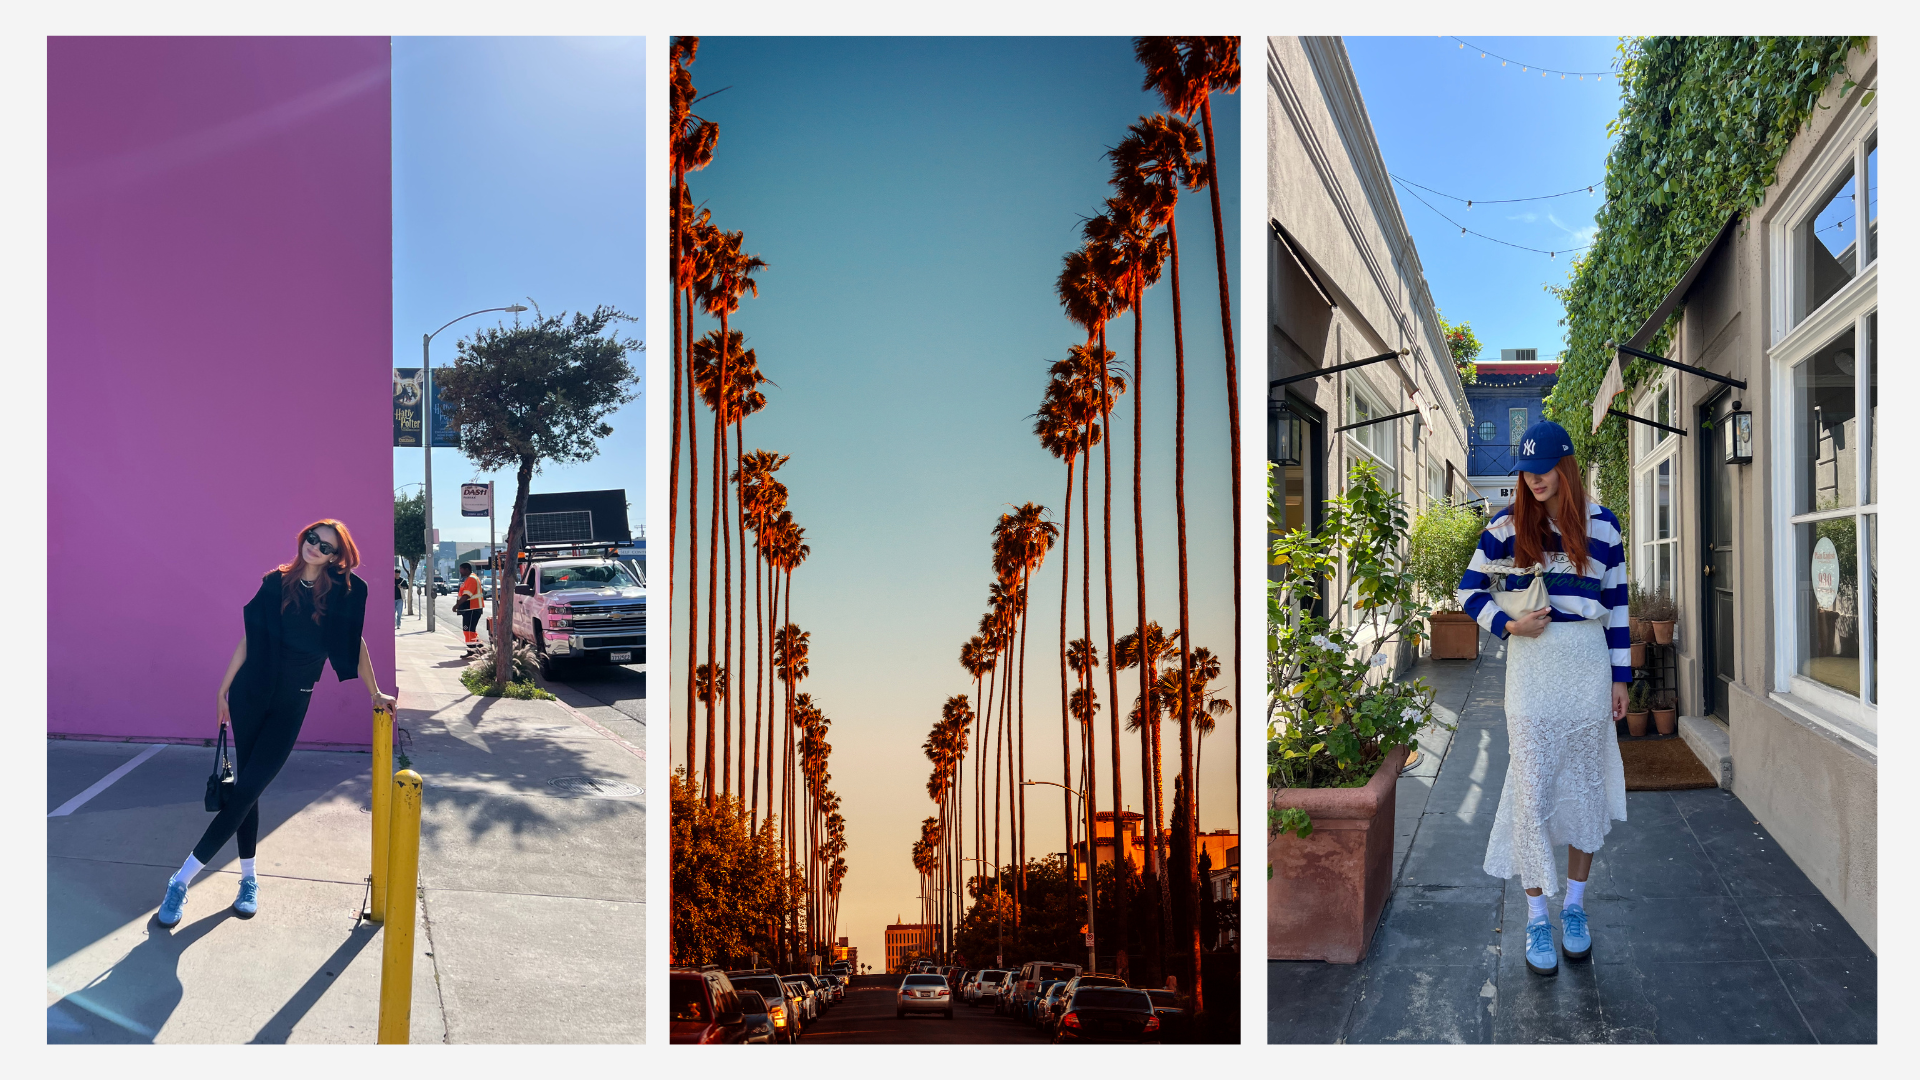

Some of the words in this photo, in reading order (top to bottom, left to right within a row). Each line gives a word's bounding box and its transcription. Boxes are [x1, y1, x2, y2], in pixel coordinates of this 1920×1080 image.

[395, 408, 414, 420] Harry
[401, 417, 420, 429] Potter
[1523, 439, 1536, 456] NY
[1818, 572, 1832, 587] 930
